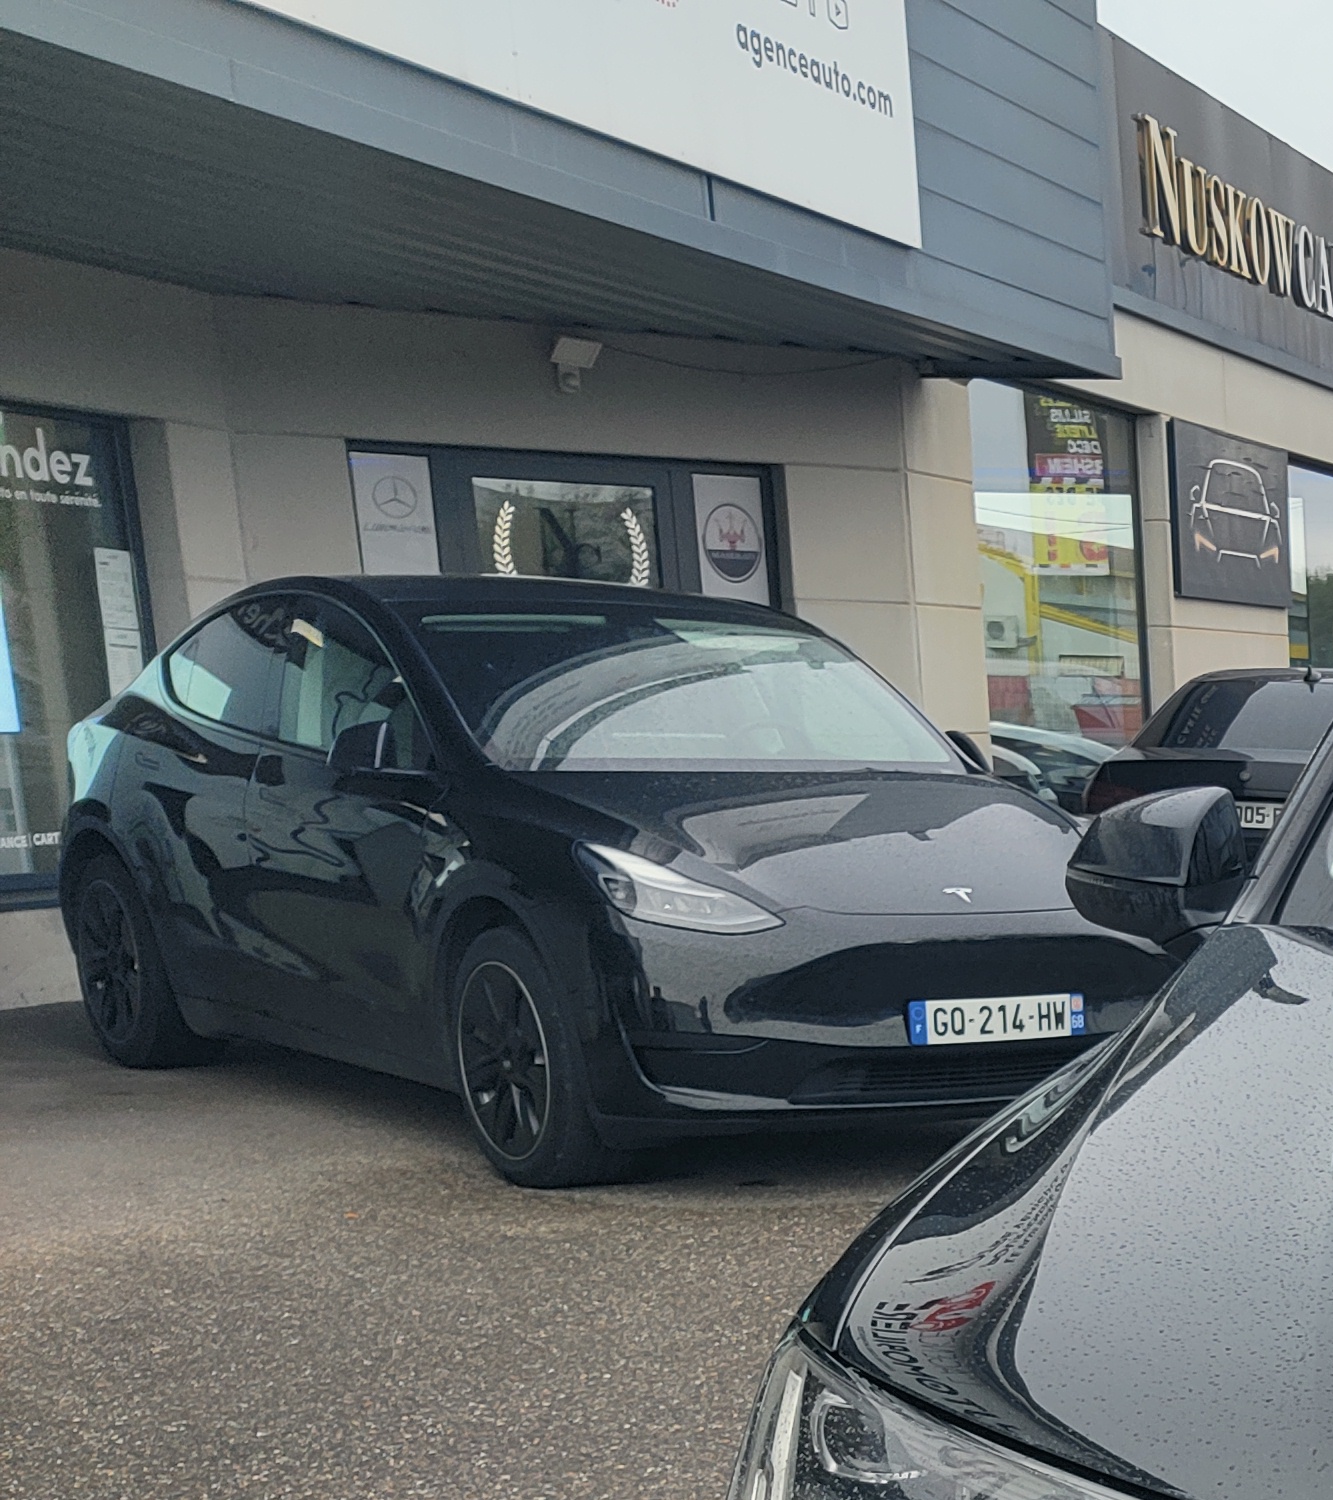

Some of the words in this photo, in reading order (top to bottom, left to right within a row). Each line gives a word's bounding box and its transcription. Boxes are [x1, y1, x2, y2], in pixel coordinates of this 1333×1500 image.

[736, 23, 894, 118] agenceauto.com
[933, 1001, 1066, 1037] GQ-214-HW
[1072, 1014, 1085, 1029] 68
